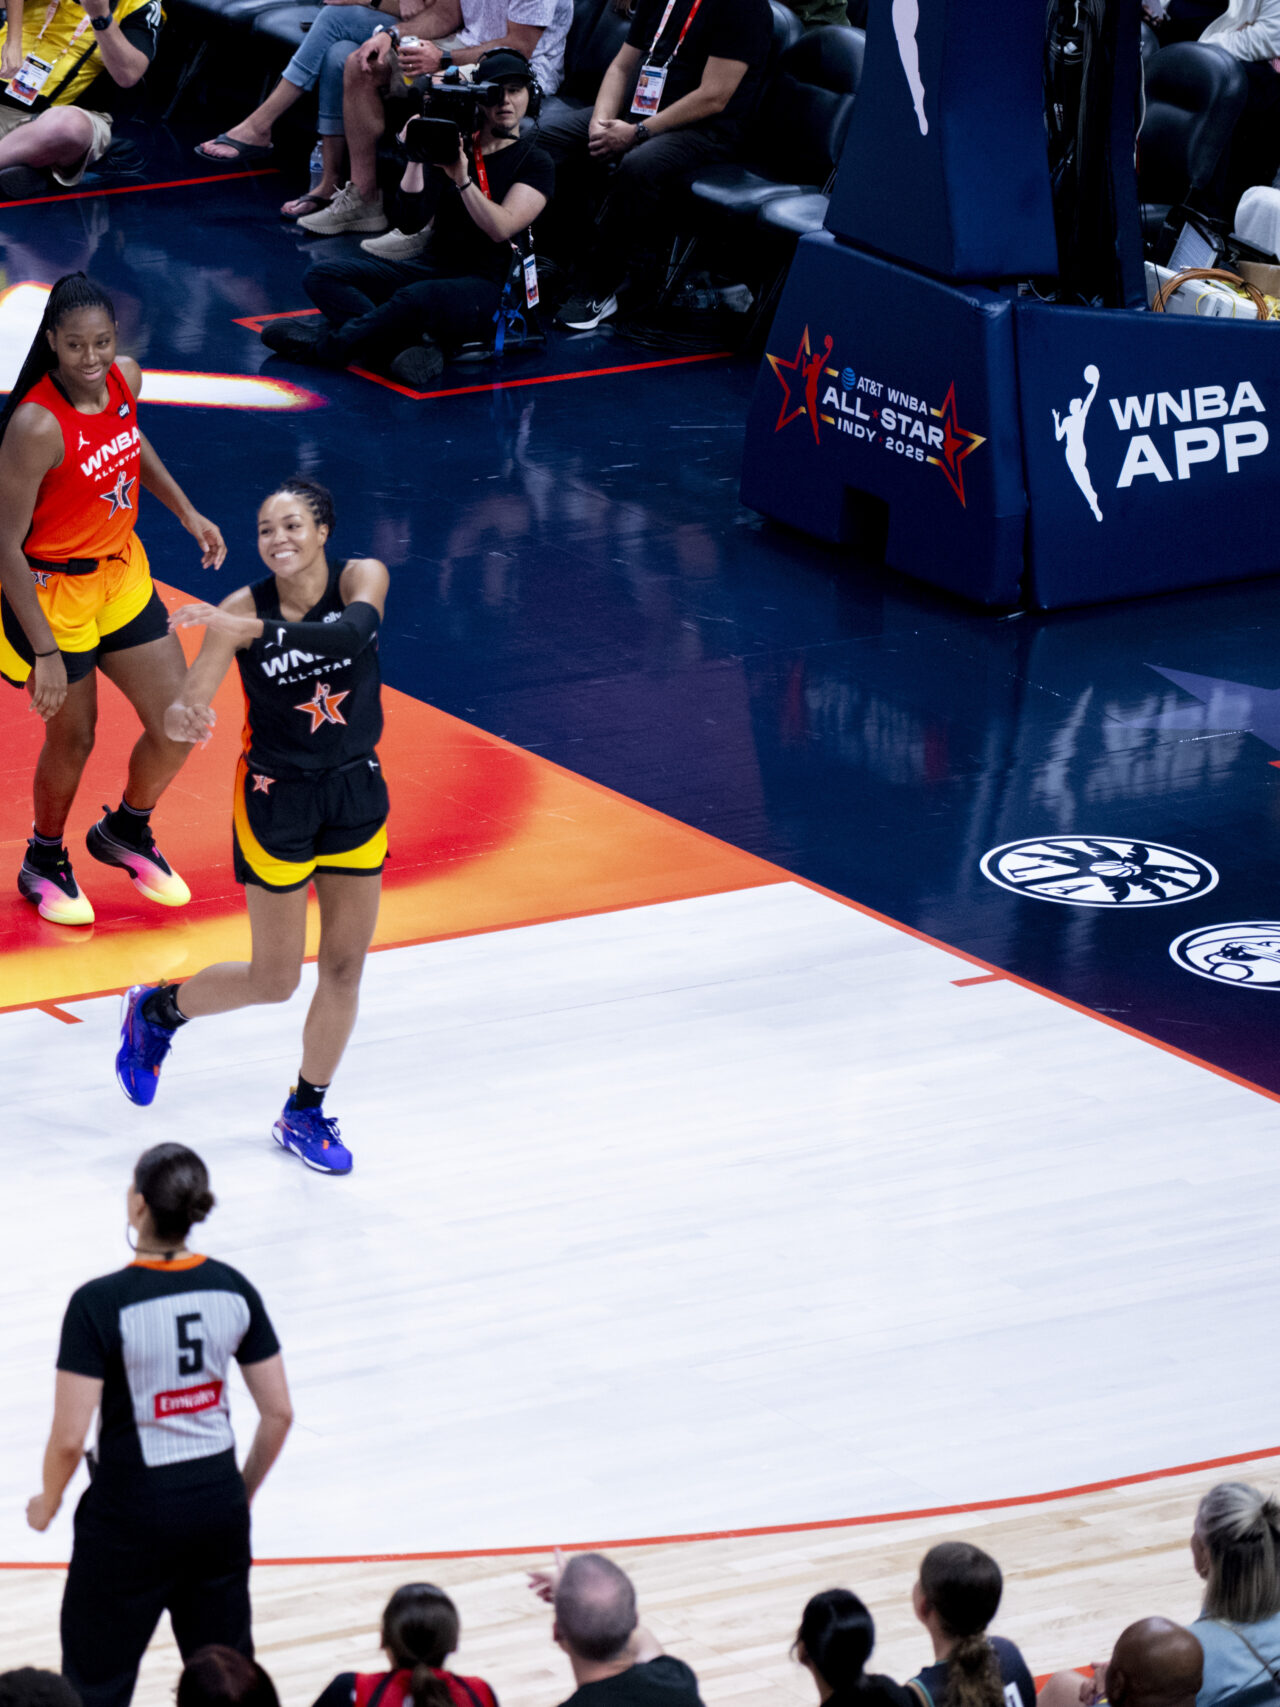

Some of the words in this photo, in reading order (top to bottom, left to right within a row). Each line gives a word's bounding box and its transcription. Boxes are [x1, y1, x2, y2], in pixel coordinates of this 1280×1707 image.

[822, 386, 870, 421] ALL
[880, 407, 945, 450] STAR
[856, 376, 884, 398] AT&T
[887, 387, 928, 416] WNBA
[1109, 381, 1266, 431] WNBA
[80, 426, 140, 477] WNBA
[837, 417, 877, 443] INDY
[885, 436, 925, 462] 2025
[1116, 420, 1269, 489] APP
[278, 658, 352, 685] ALL-STAR
[177, 1312, 204, 1377] 5
